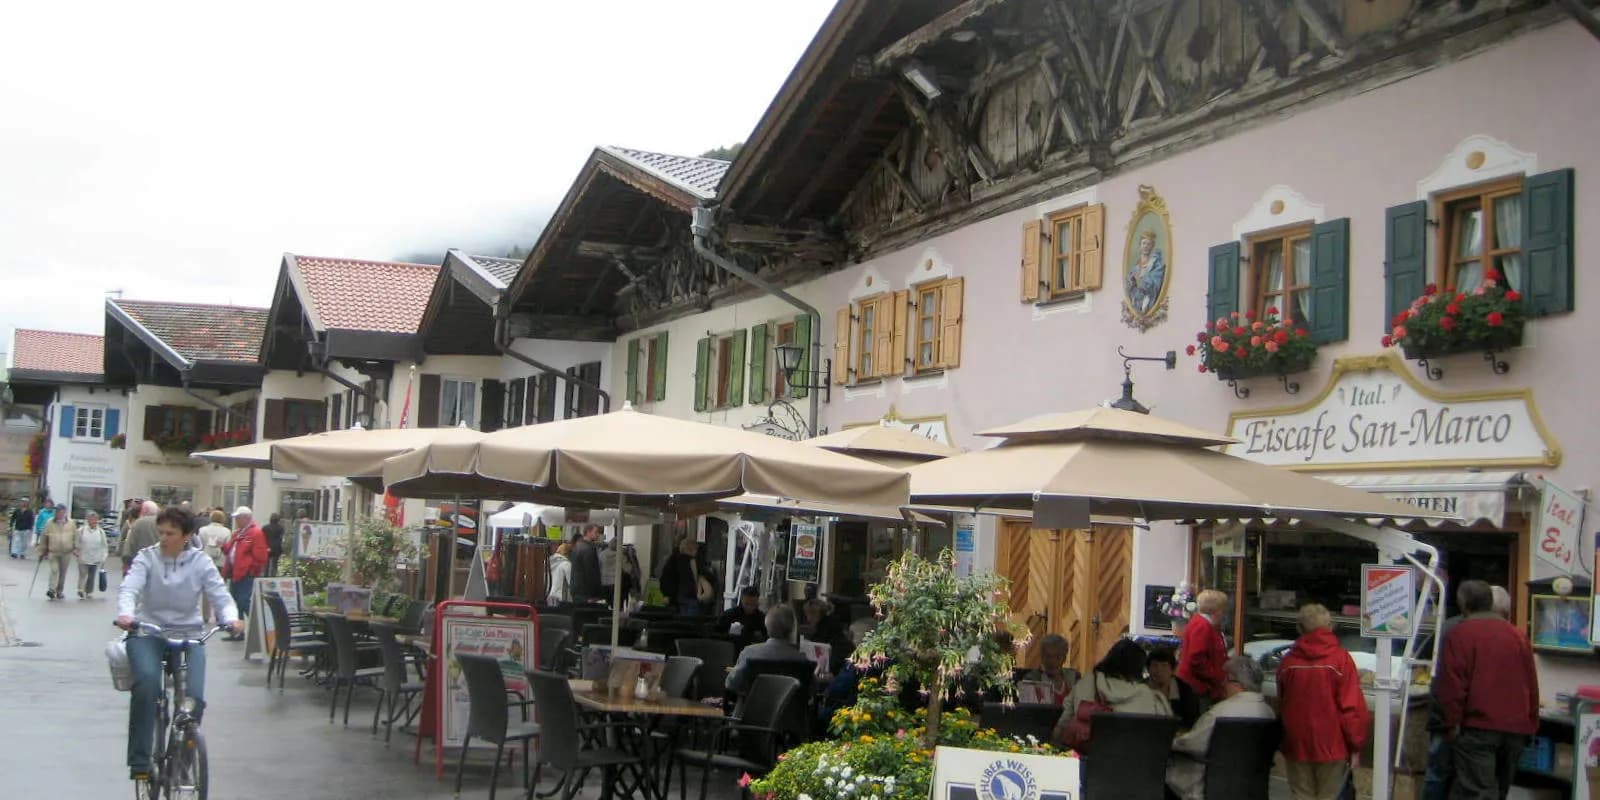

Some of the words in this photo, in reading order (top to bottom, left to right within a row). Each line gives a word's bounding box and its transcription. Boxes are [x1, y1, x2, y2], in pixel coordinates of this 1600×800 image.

[1351, 383, 1386, 406] Ital.
[1245, 410, 1336, 462] Eiscafe
[1341, 407, 1512, 453] San-Marco
[1541, 527, 1572, 565] Eis
[980, 760, 1004, 793] HUBER
[1007, 759, 1037, 797] WEISSES
